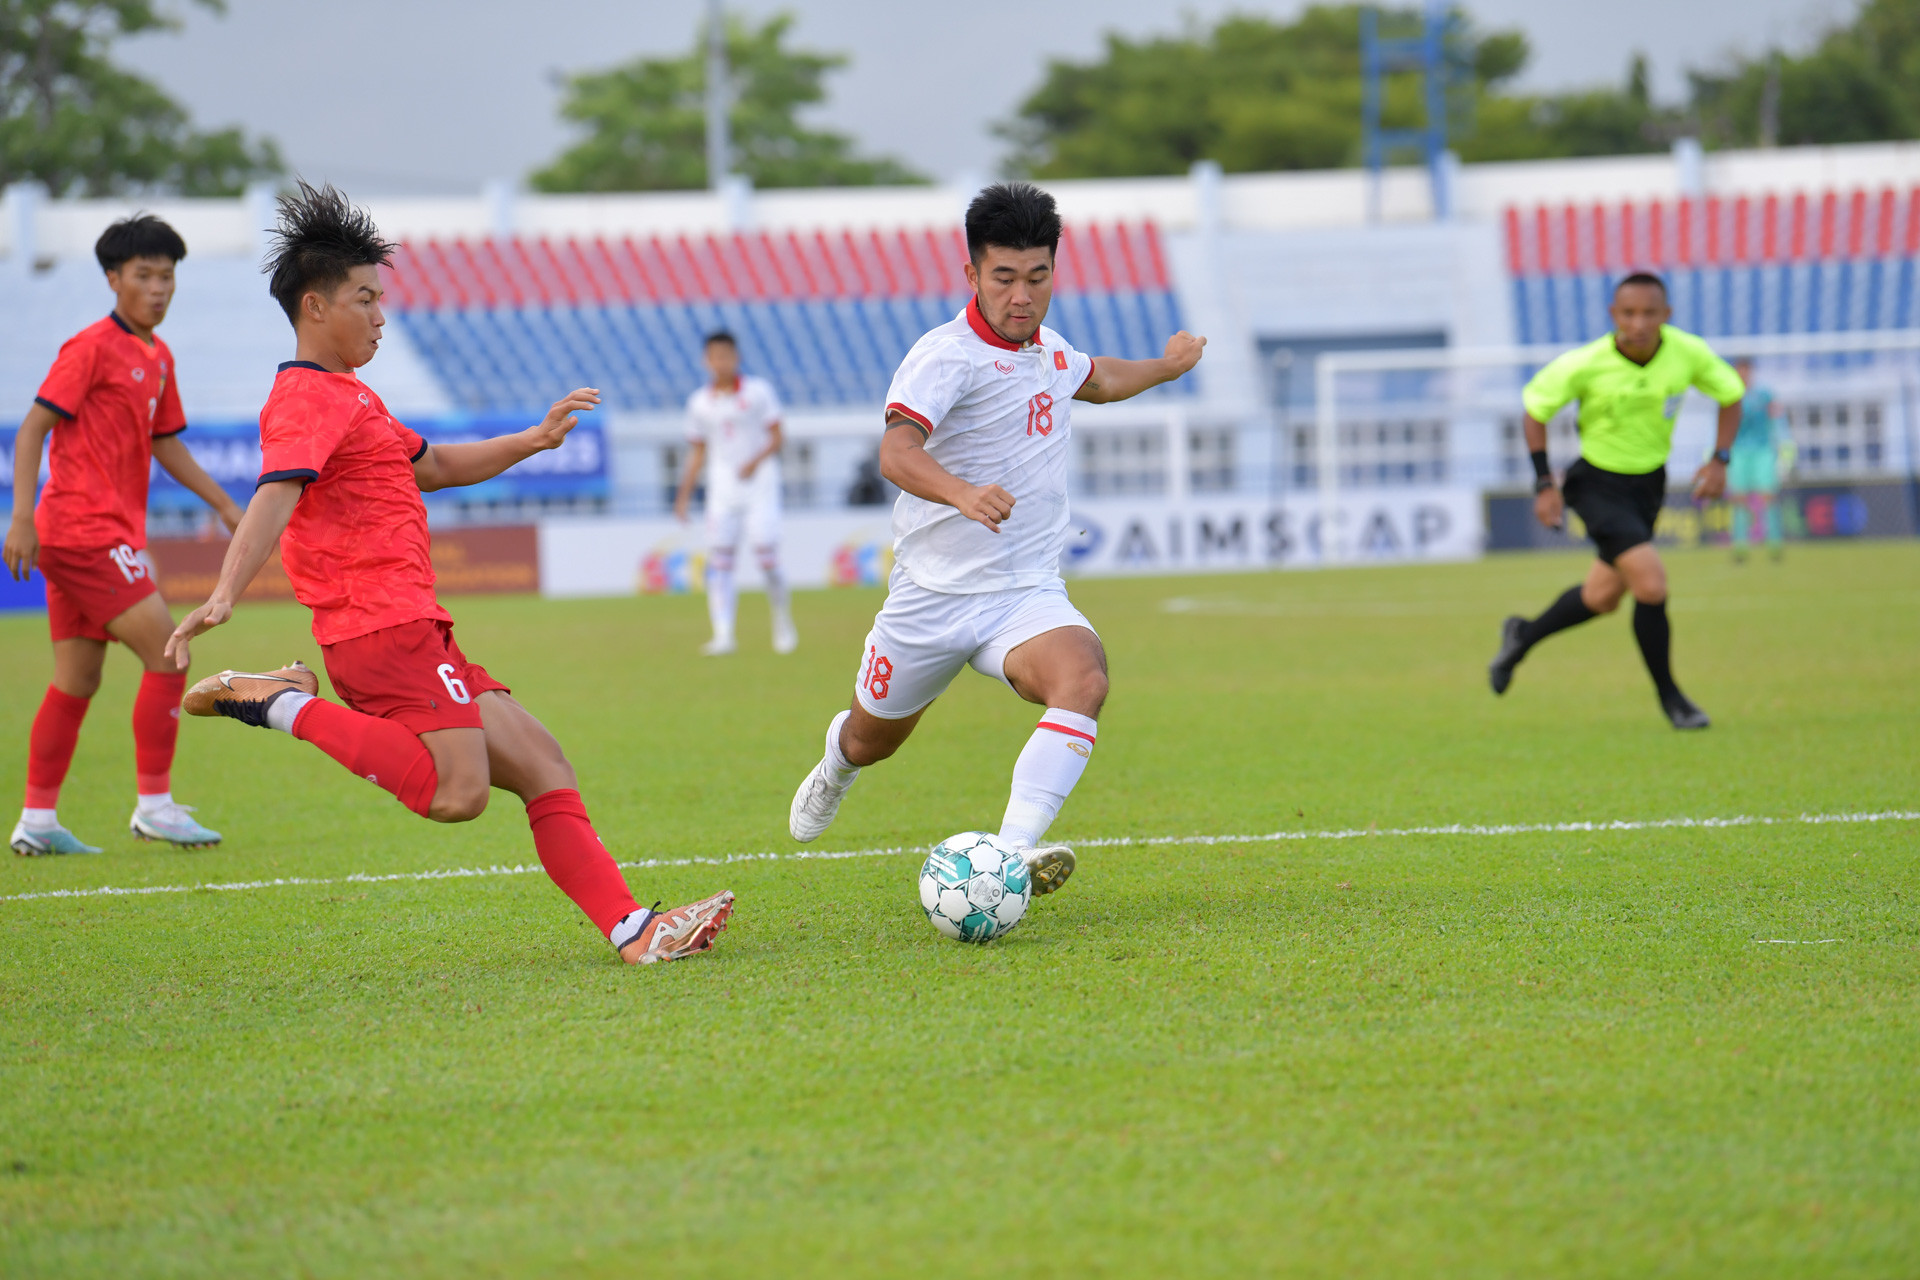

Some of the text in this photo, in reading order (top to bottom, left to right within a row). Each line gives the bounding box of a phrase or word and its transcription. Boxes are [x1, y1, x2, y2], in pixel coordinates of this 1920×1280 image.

[1026, 392, 1053, 436] 18
[109, 544, 147, 584] 19
[437, 663, 471, 704] 6
[864, 645, 893, 700] 18
